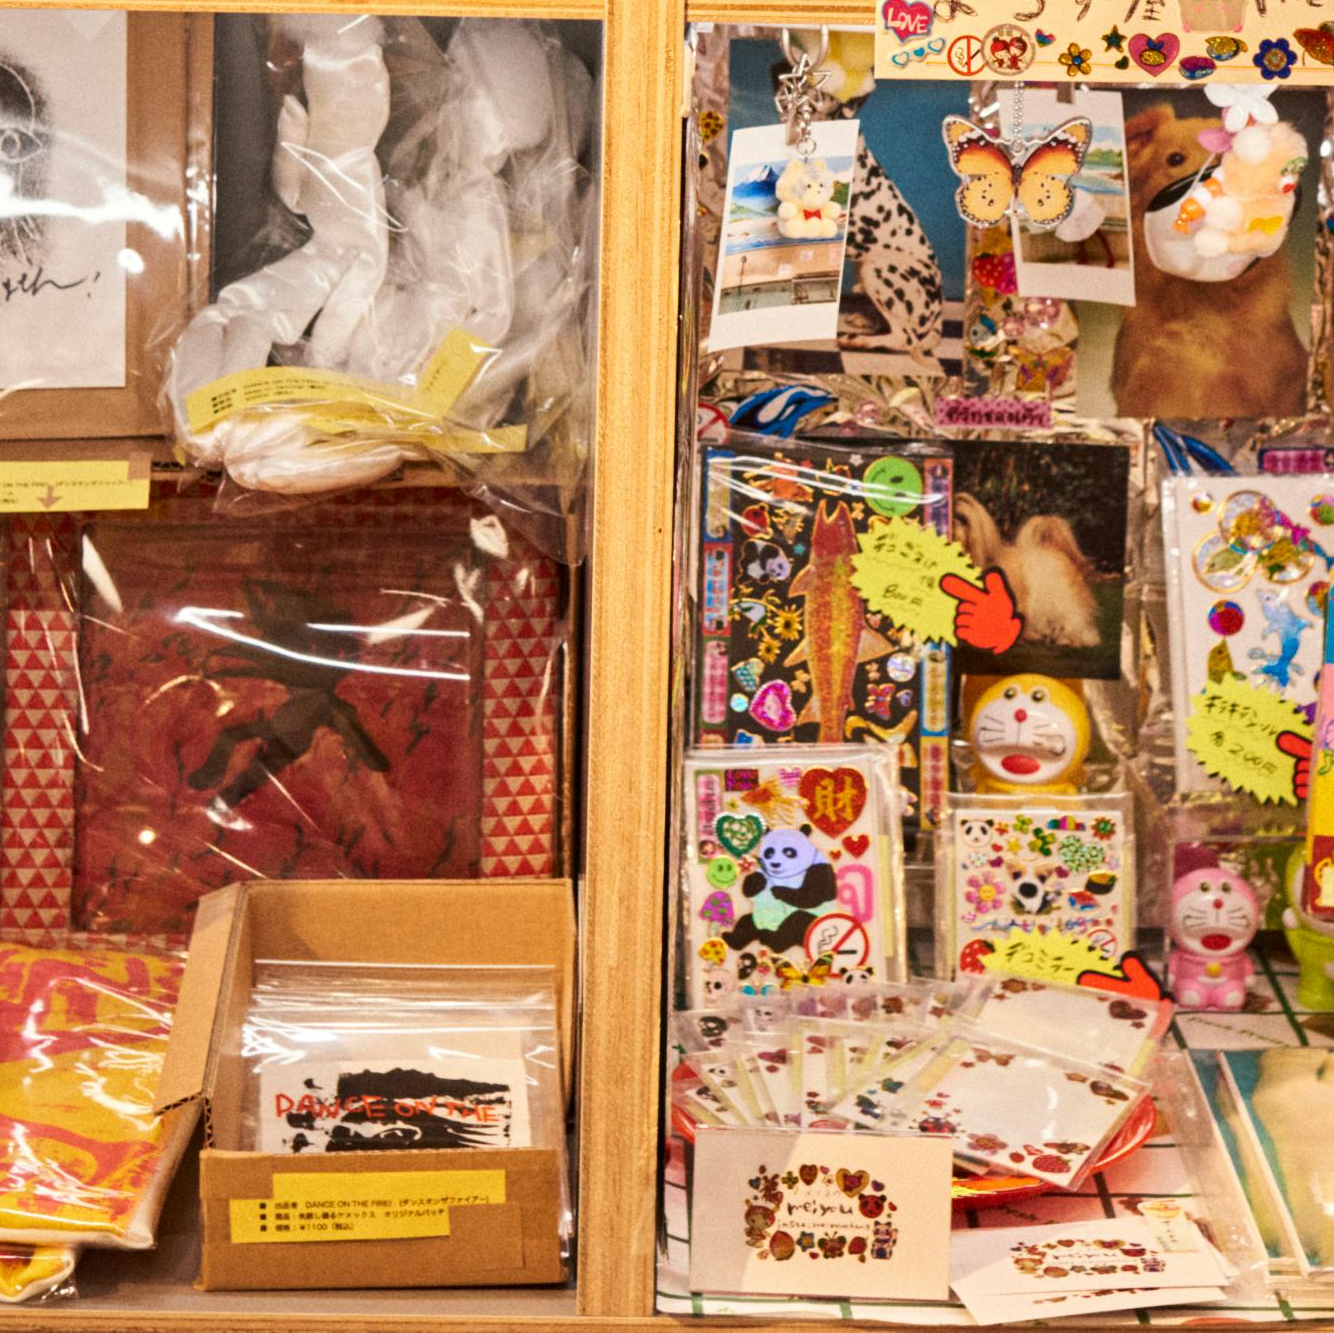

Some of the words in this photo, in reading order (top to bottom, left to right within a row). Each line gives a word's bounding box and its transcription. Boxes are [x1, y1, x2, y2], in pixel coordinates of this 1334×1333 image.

[886, 11, 929, 34] LOVE
[814, 775, 857, 822] 財
[275, 1093, 386, 1120] DANCE
[394, 1095, 439, 1116] ON
[443, 1100, 499, 1123] THE
[305, 1200, 335, 1208] DANCE
[337, 1200, 350, 1208] ON
[351, 1200, 369, 1208] THE
